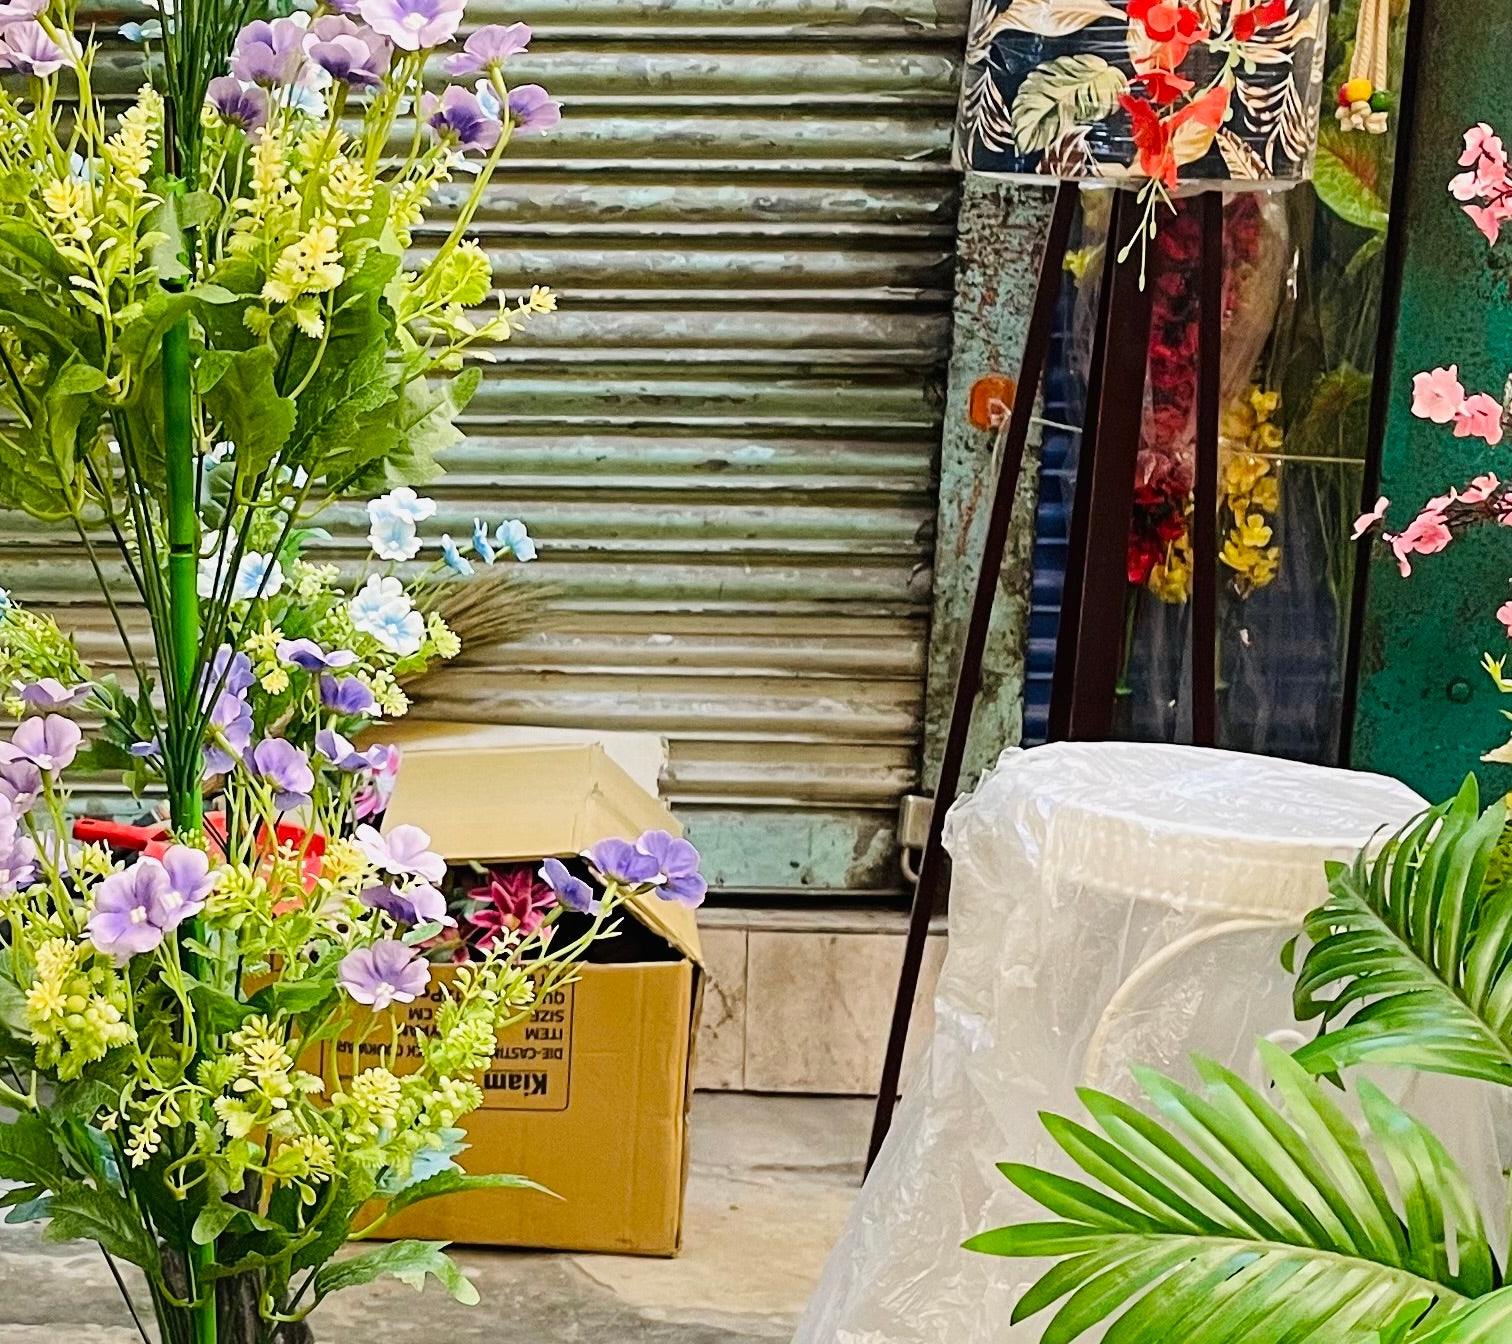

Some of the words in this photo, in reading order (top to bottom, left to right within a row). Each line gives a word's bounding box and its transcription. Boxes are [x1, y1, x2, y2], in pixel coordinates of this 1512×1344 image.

[409, 1008, 432, 1020] CM
[530, 1009, 565, 1023] SIZE
[525, 1027, 563, 1041] ITEM
[483, 1072, 547, 1096] Kiam
